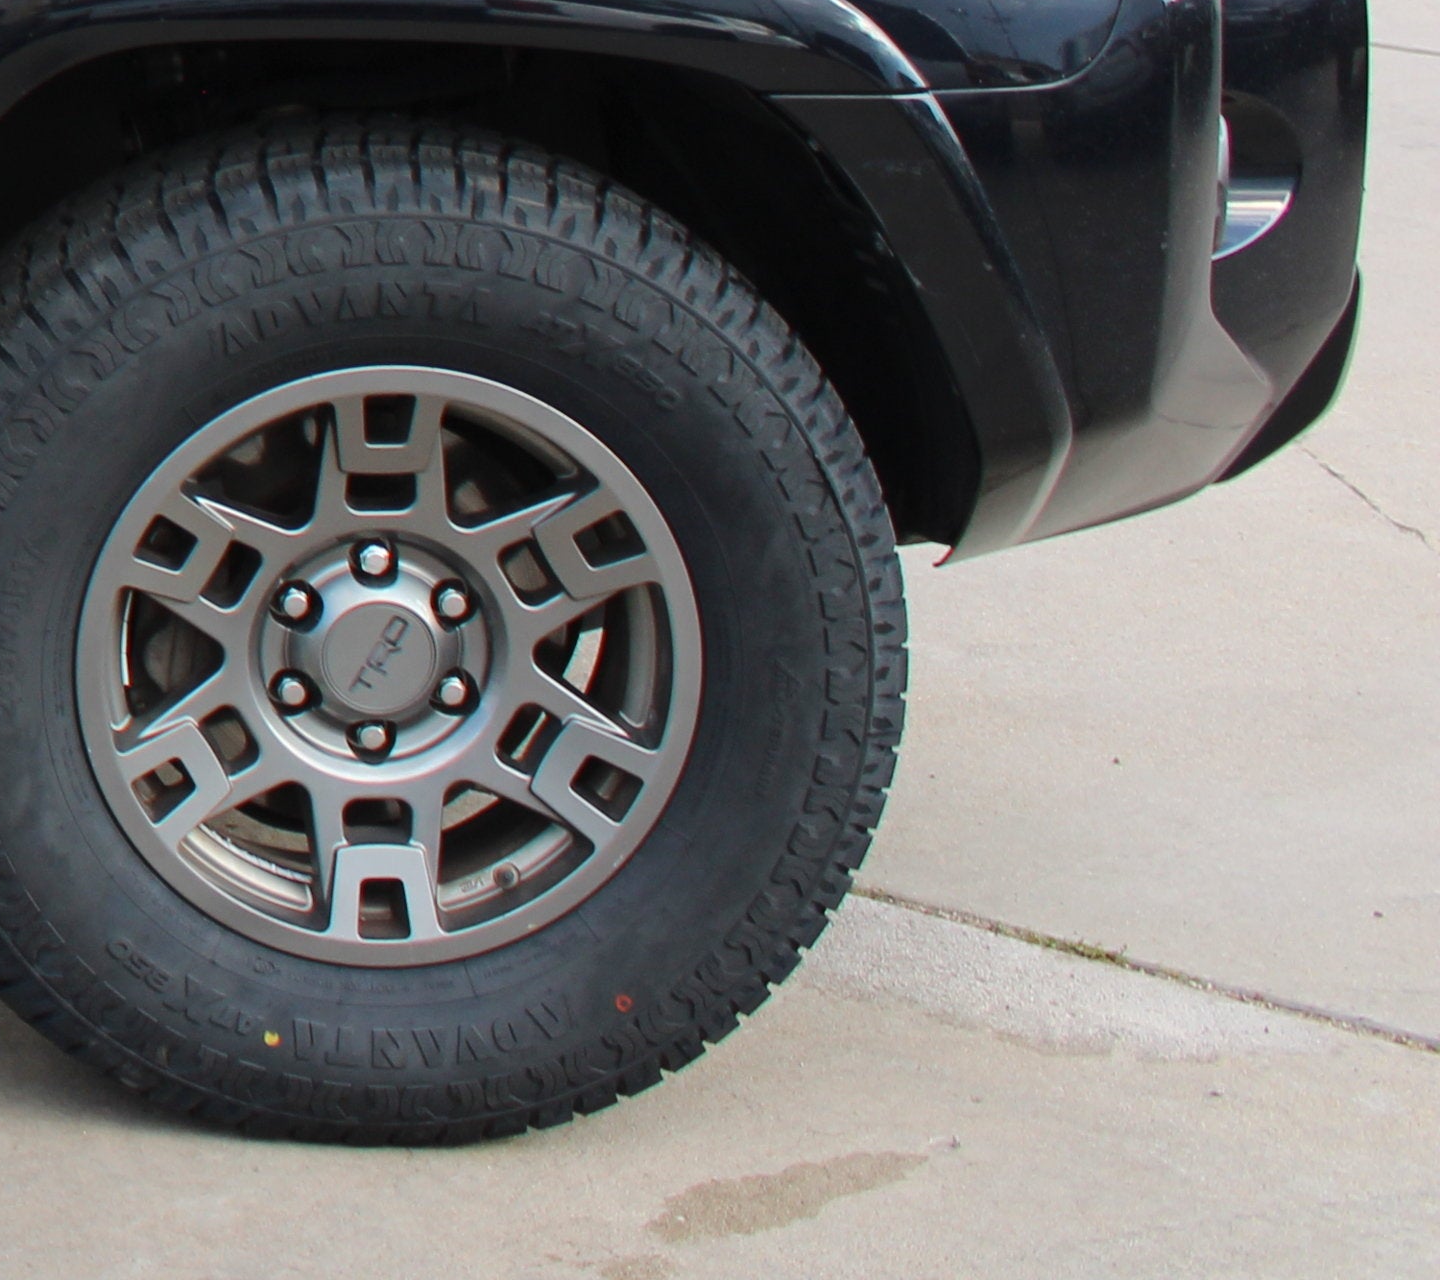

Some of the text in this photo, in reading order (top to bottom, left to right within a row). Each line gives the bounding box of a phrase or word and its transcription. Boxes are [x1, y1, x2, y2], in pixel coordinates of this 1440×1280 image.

[207, 281, 492, 356] ADVANTA
[347, 614, 410, 692] TRD
[291, 994, 580, 1070] ADVANTA
